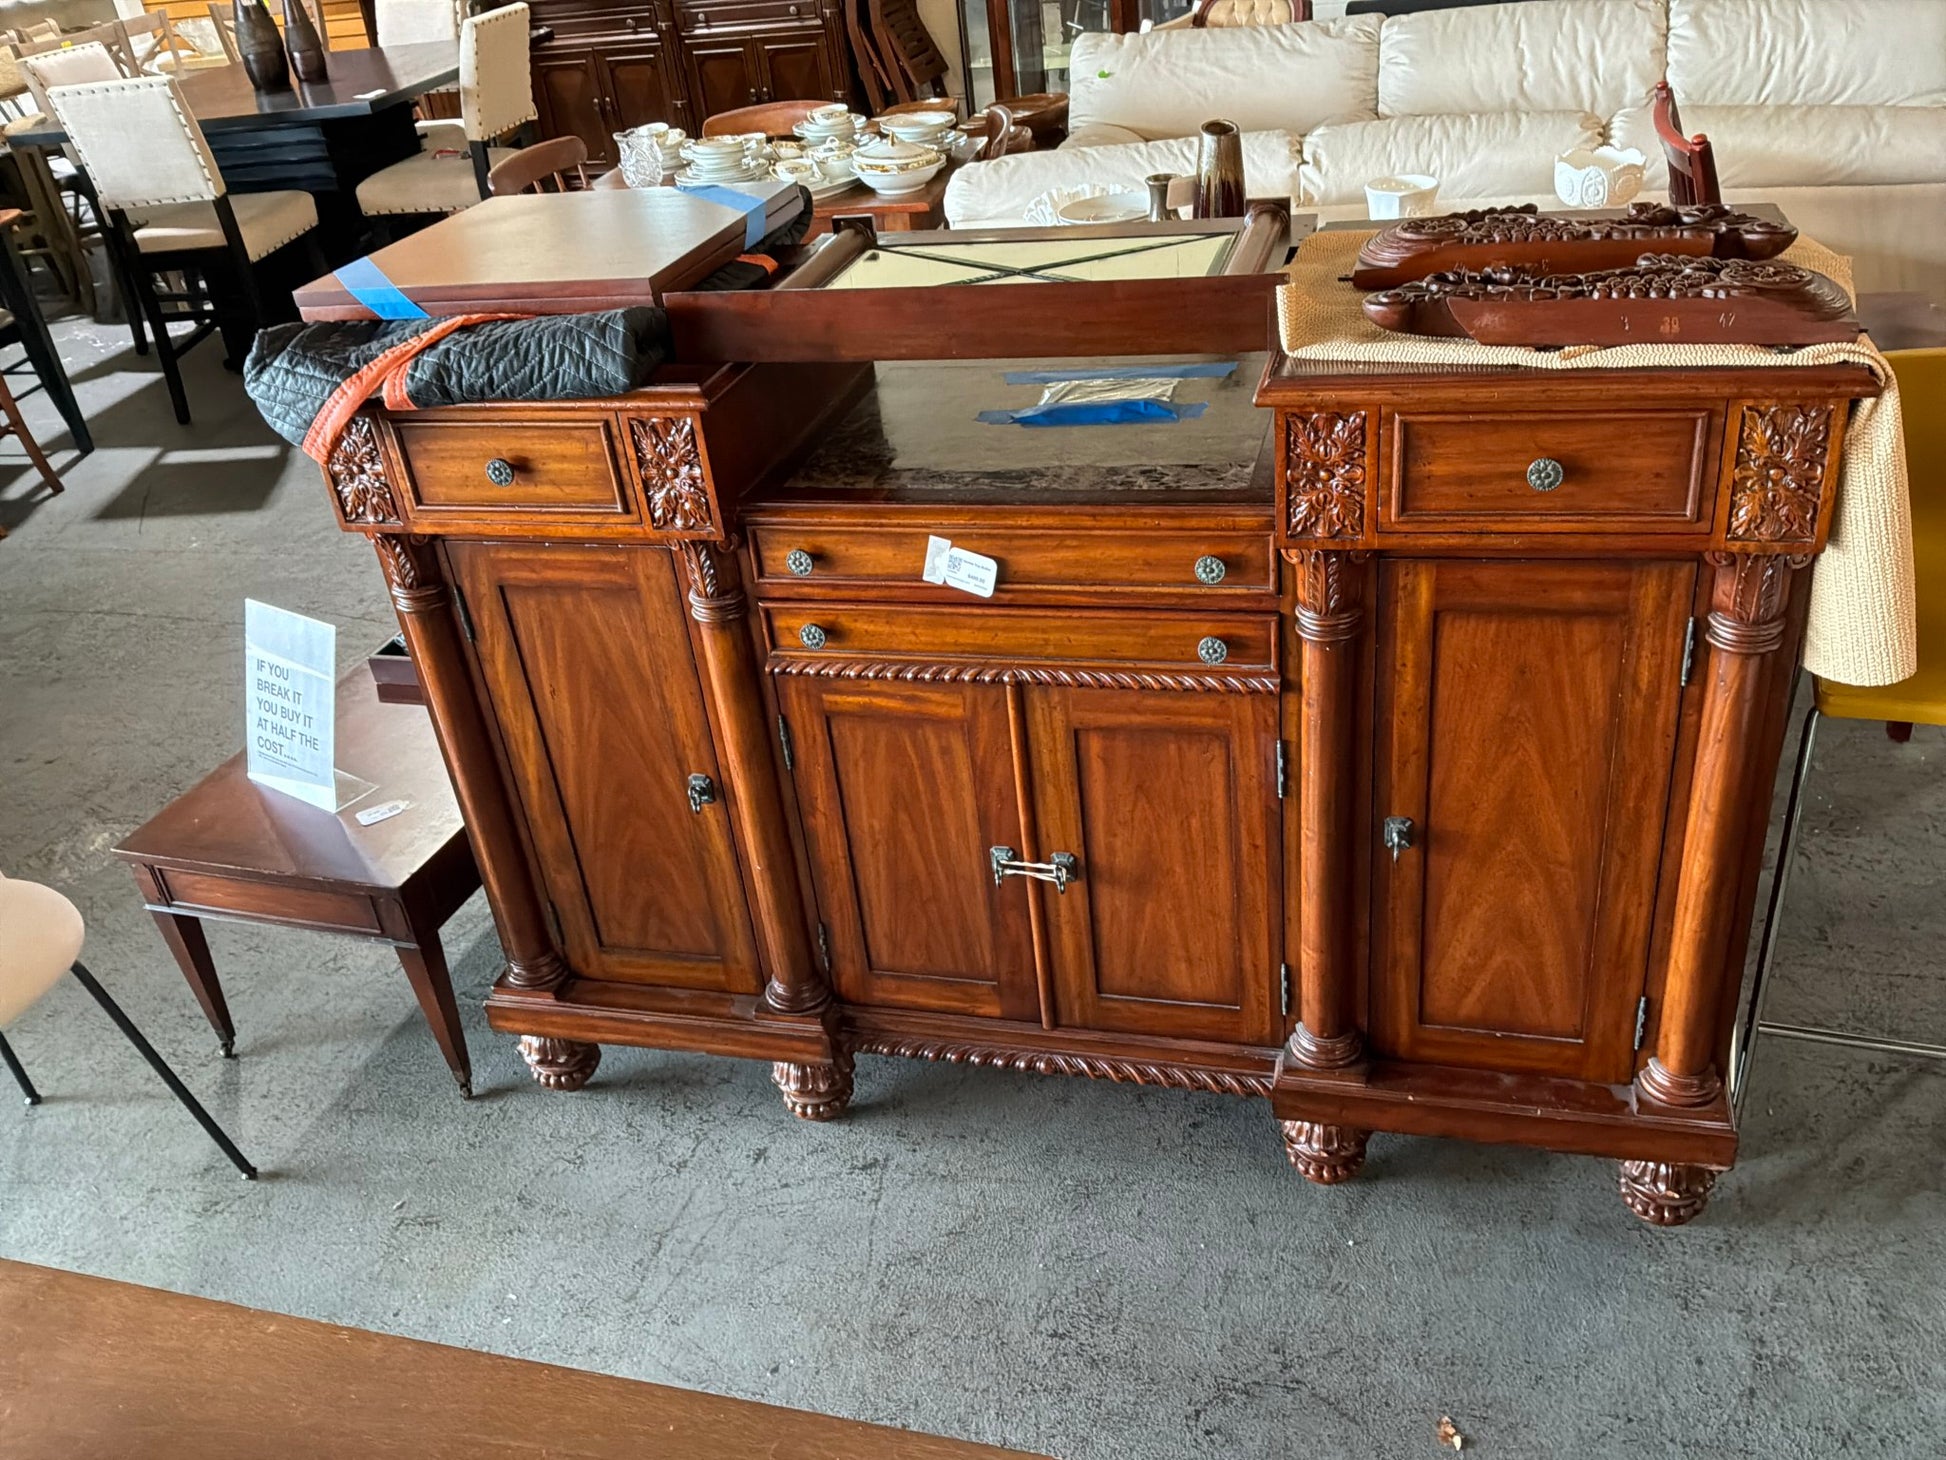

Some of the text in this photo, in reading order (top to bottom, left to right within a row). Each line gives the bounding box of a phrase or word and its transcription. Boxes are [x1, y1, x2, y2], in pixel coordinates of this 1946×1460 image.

[257, 658, 289, 681] IF YOU
[257, 678, 302, 705] BREAK IT
[257, 696, 313, 729] YOU BUY IT
[257, 717, 319, 751] AT HALF THE
